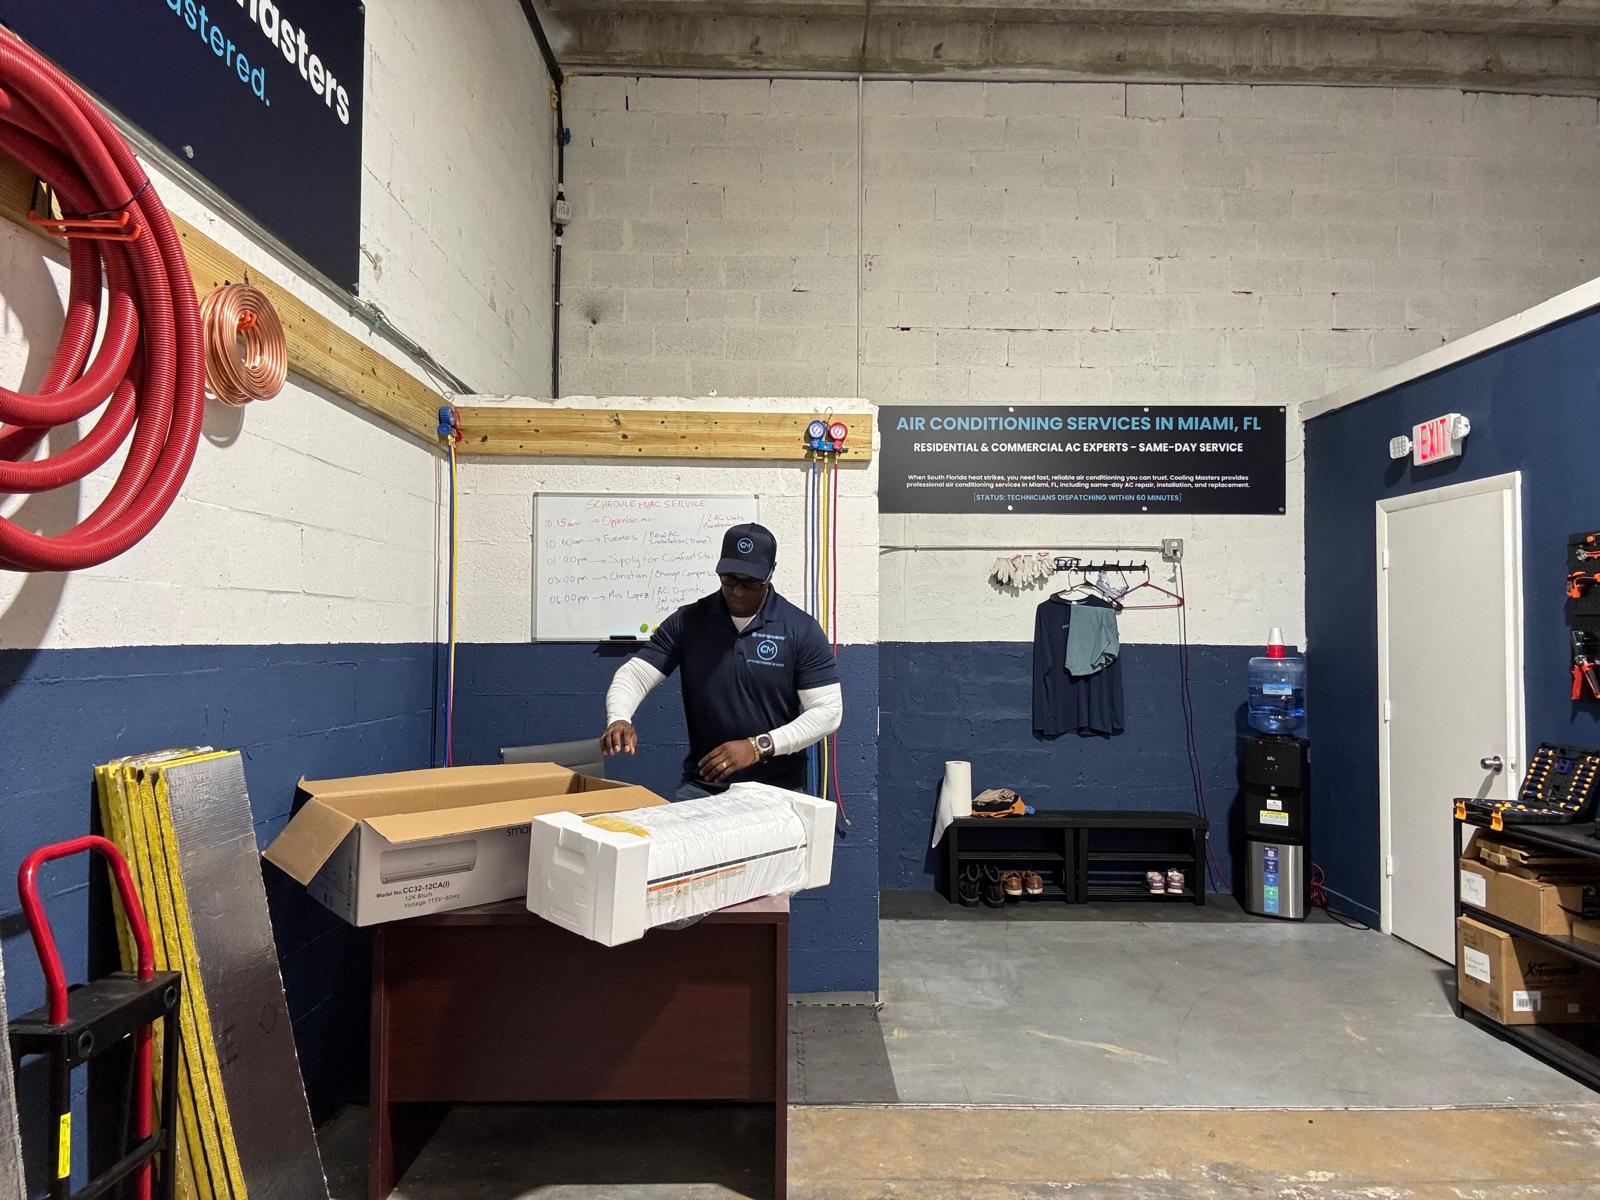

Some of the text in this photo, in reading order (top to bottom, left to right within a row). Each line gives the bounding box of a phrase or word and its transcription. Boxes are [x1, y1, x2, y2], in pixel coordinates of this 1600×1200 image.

[236, 0, 350, 125] asters
[896, 416, 1262, 432] AIR CONDITIONING SERVICES IN MIAMI, FL
[1420, 418, 1446, 461] EXIT
[913, 442, 979, 452] RESIDENTIAL
[980, 442, 989, 452] &
[991, 442, 1063, 452] COMMERCIAL
[1065, 442, 1081, 452] AC
[1083, 442, 1129, 452] EXPERTS
[1138, 442, 1198, 452] SAME-DAY
[1199, 442, 1244, 452] SERVICE
[1085, 474, 1125, 482] conditioning
[1169, 474, 1194, 482] Cooling
[1221, 474, 1249, 482] provides
[906, 481, 945, 489] professional
[954, 481, 994, 489] conditioning
[1059, 481, 1089, 489] including
[1090, 481, 1123, 489] same-day
[1135, 481, 1156, 489] repair,
[586, 499, 636, 510] SCHEDULE
[663, 499, 705, 509] SERVICE
